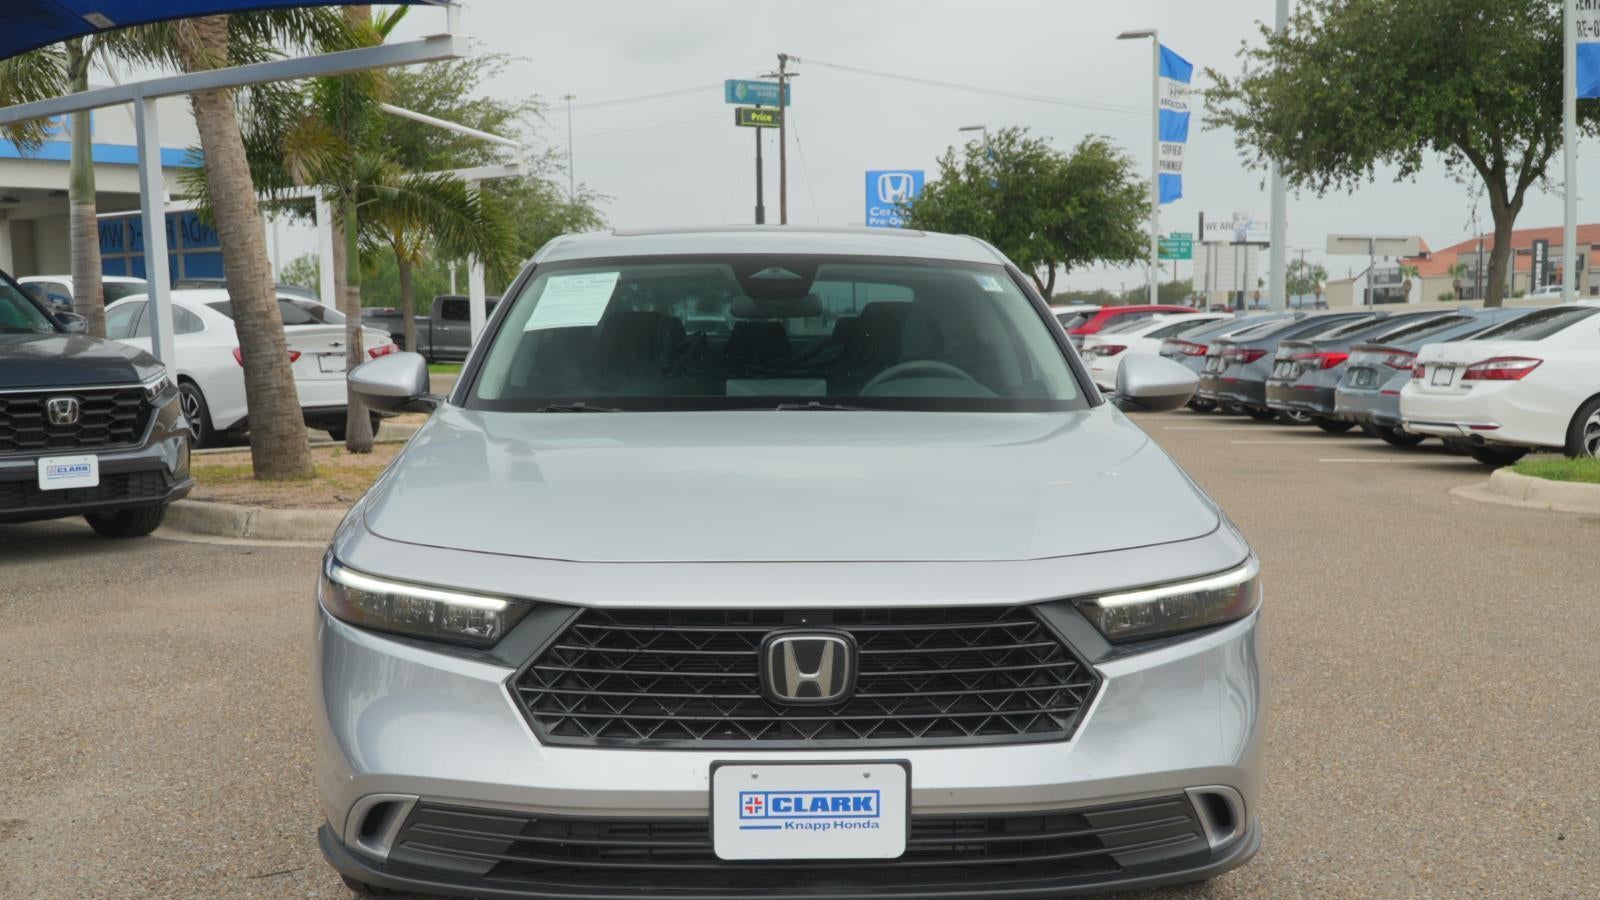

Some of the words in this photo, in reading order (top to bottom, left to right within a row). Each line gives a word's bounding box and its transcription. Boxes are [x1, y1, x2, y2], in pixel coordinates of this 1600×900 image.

[751, 112, 772, 122] Price
[57, 465, 88, 474] CLARK
[772, 796, 873, 813] CLARK
[784, 820, 831, 831] Knapp
[833, 820, 880, 830] Honda
